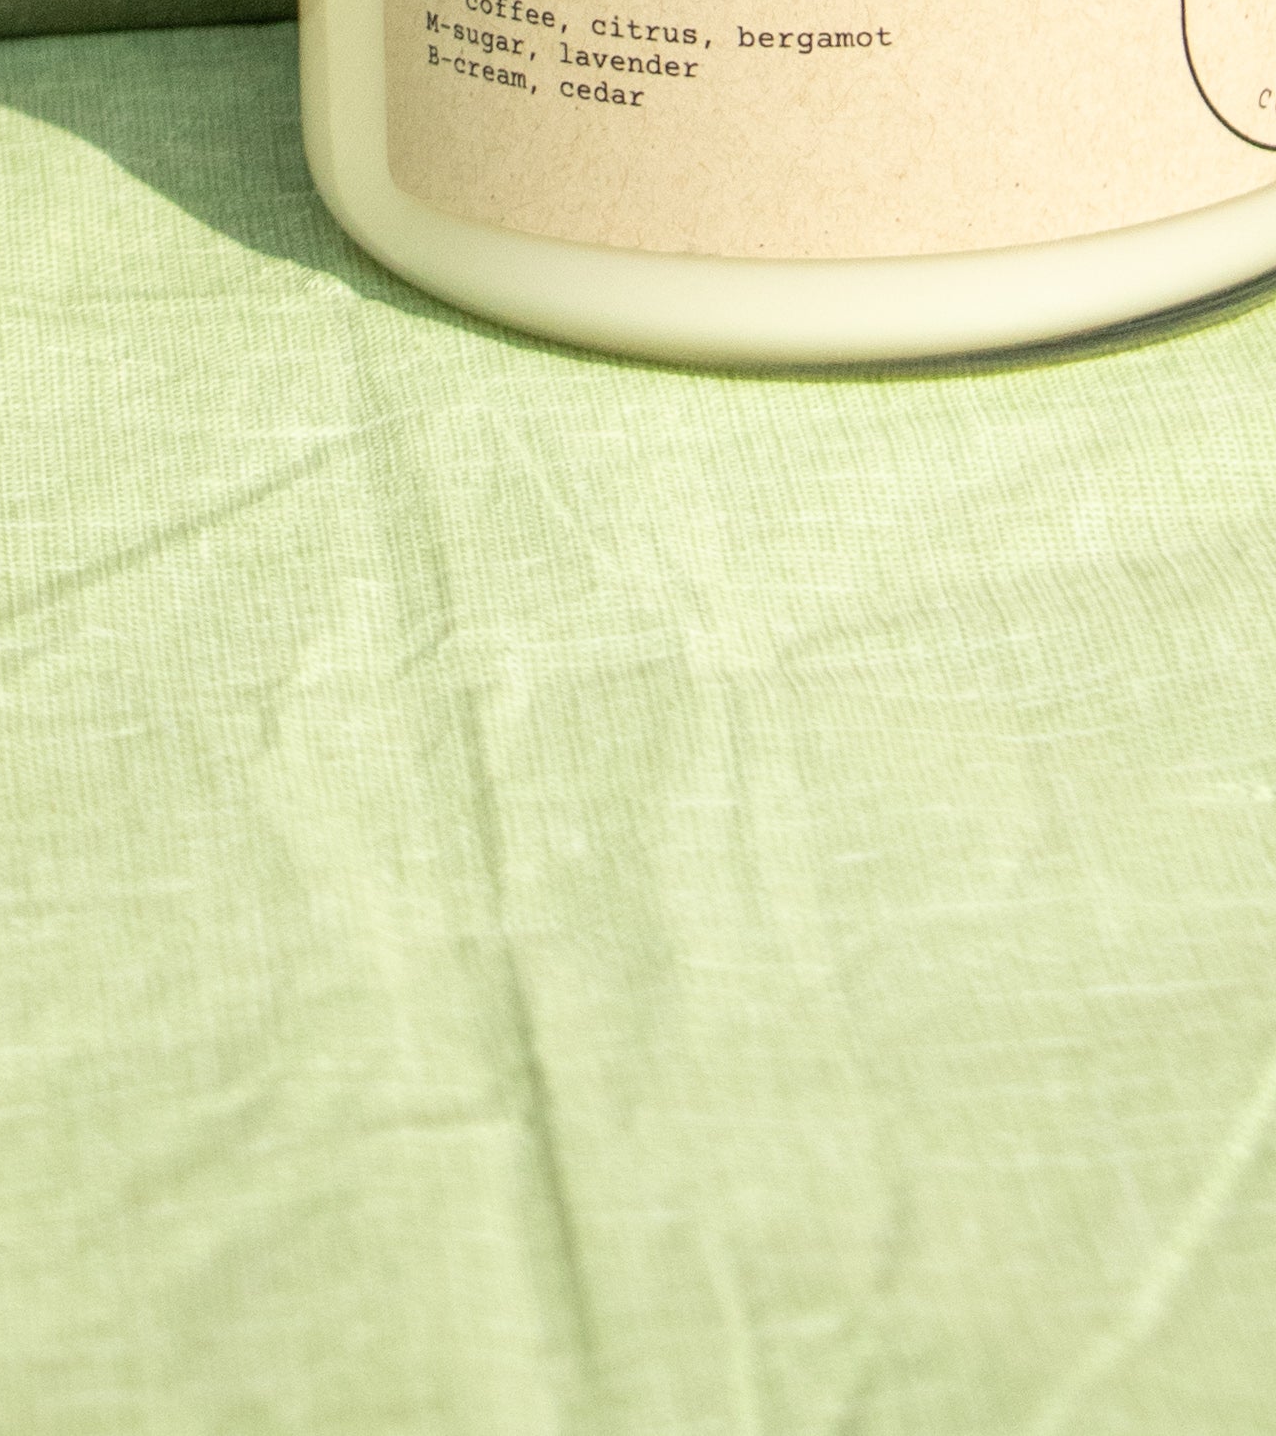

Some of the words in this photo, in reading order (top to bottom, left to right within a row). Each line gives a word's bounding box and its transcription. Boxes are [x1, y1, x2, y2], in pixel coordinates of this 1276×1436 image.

[425, 11, 538, 62] M-sugar,
[559, 43, 699, 79] lavender
[591, 16, 714, 51] citrus,
[736, 25, 893, 55] bergamot
[427, 44, 539, 96] B-cream,
[559, 78, 645, 108] cedar
